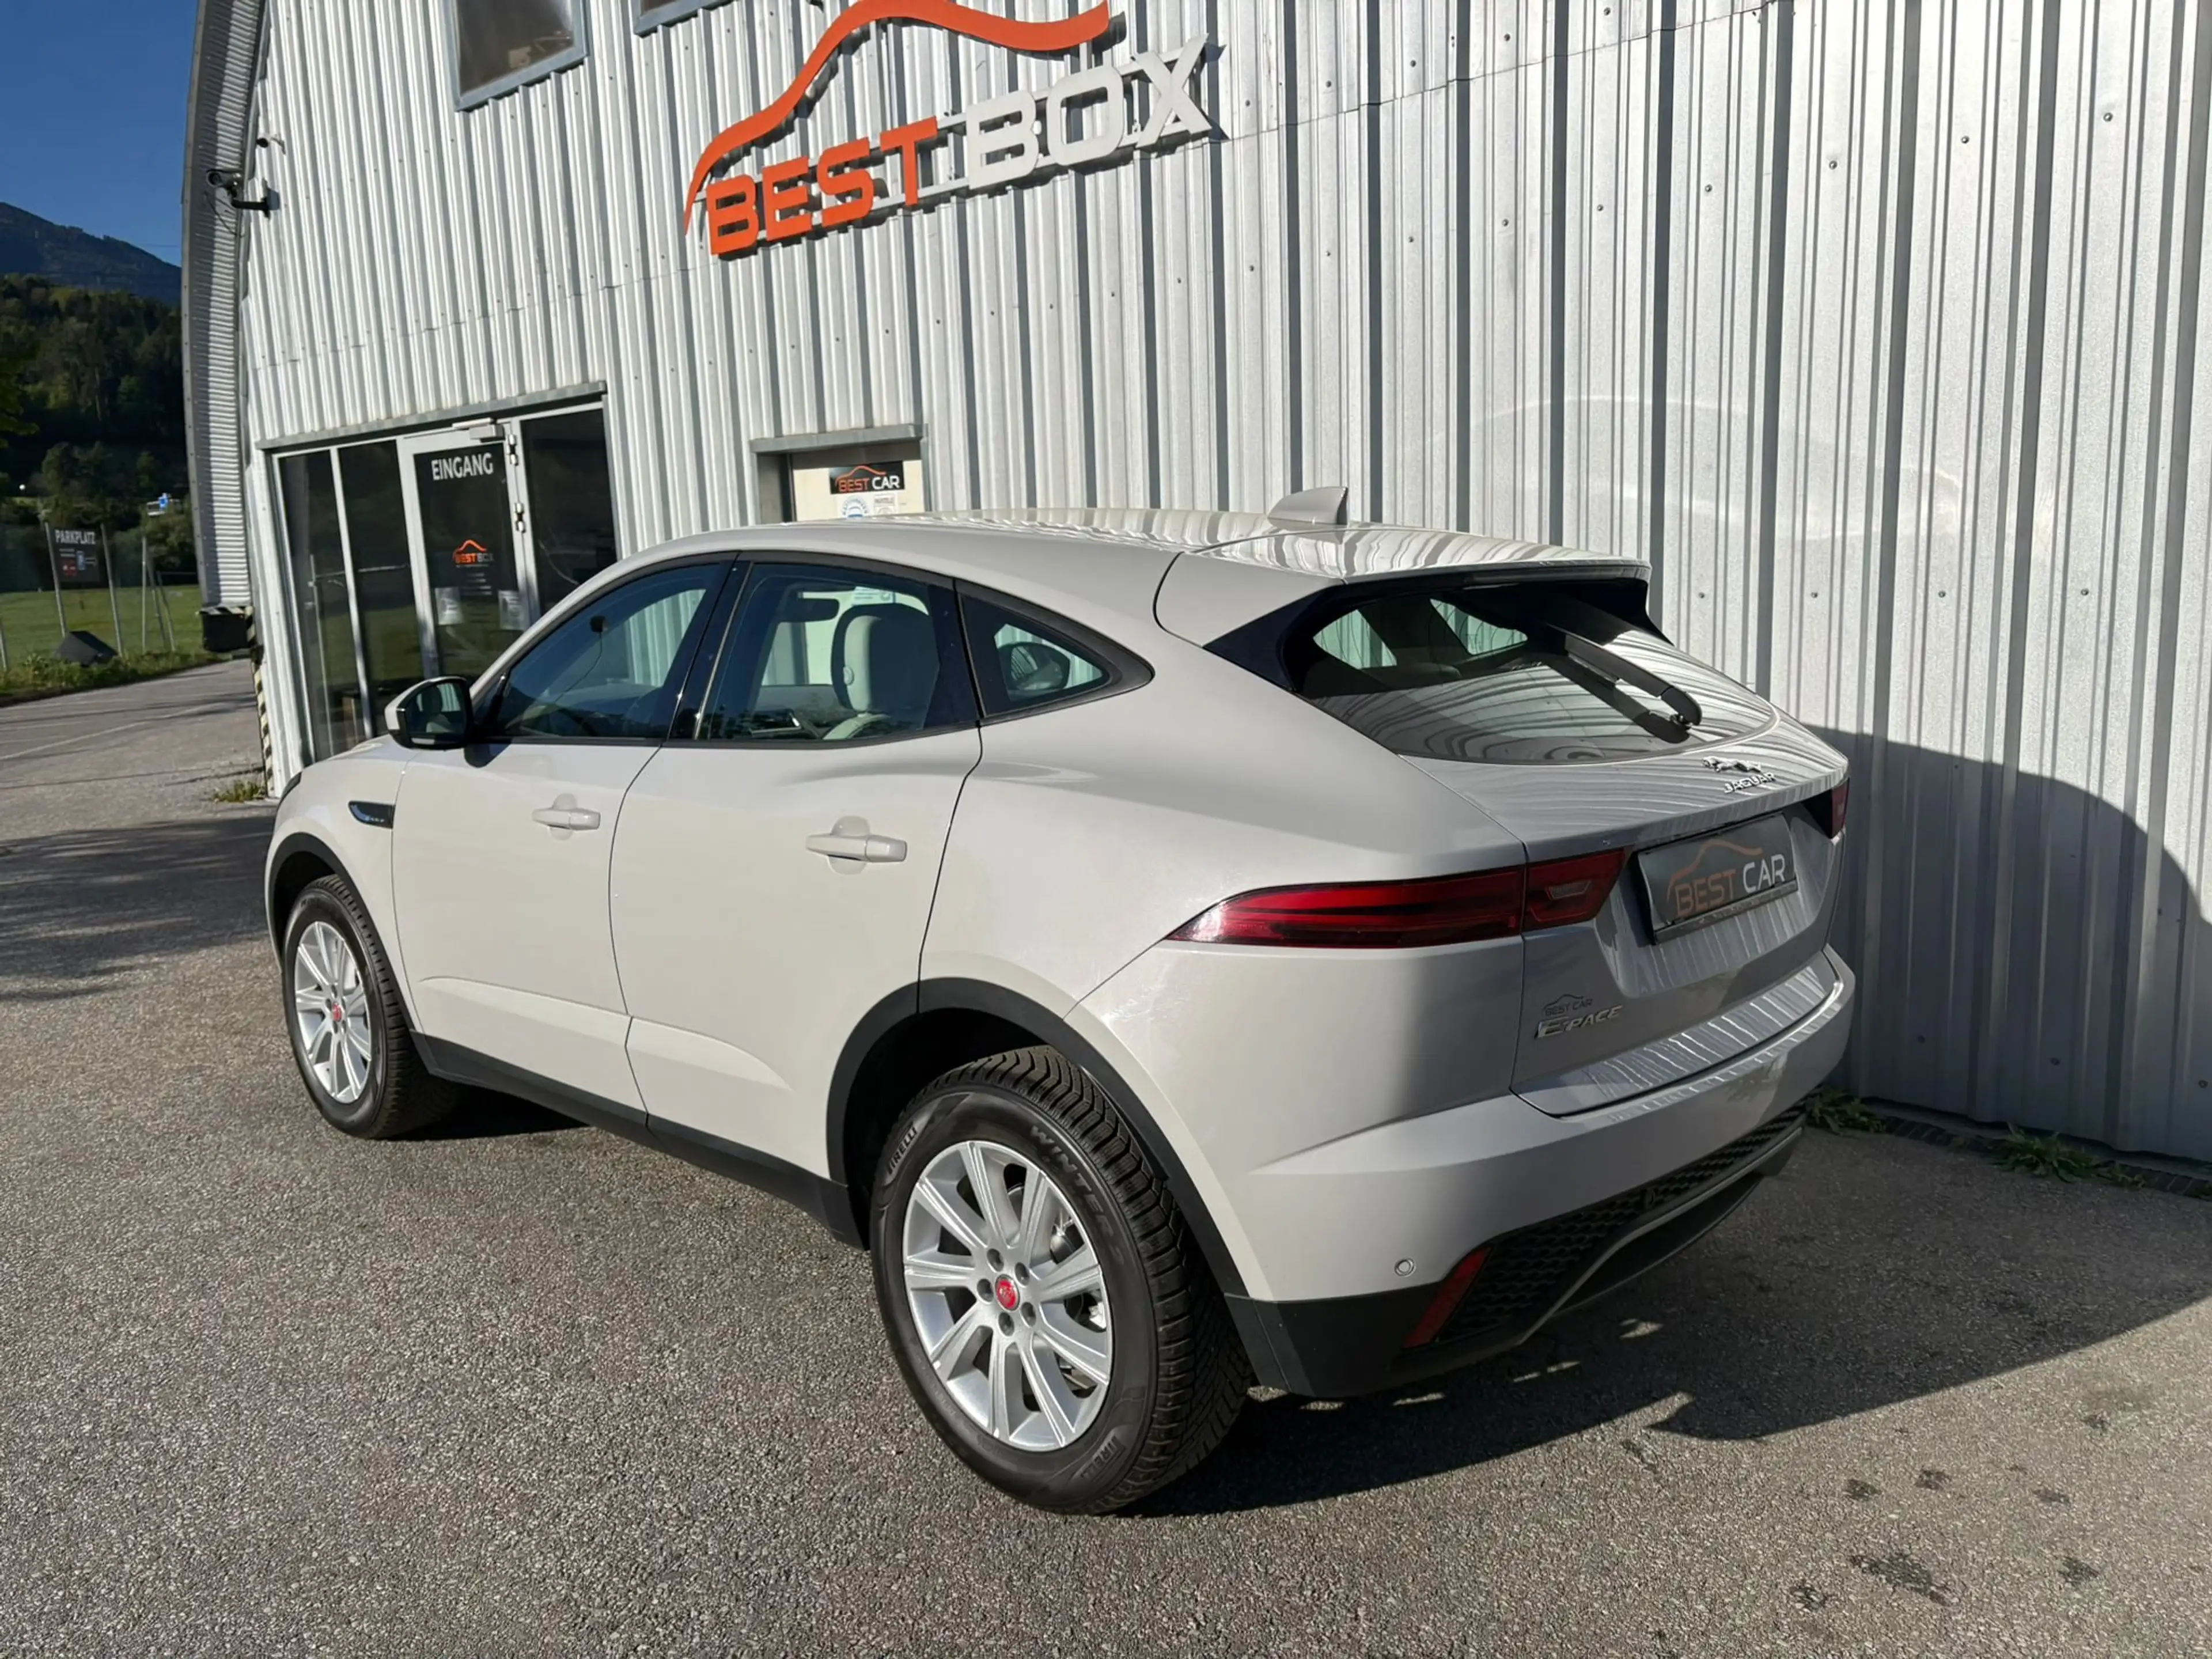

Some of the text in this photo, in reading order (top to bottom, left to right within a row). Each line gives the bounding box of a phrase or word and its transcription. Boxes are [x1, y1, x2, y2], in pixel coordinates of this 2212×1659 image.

[431, 452, 494, 480] EINGANG
[838, 475, 900, 492] BEST CAR
[1724, 772, 1775, 794] JAGUAR
[1675, 854, 1786, 918] BEST CAR
[1546, 998, 1593, 1017] BEST CAR
[888, 1122, 918, 1175] PIRELLI
[1030, 1125, 1114, 1237] WINTER
